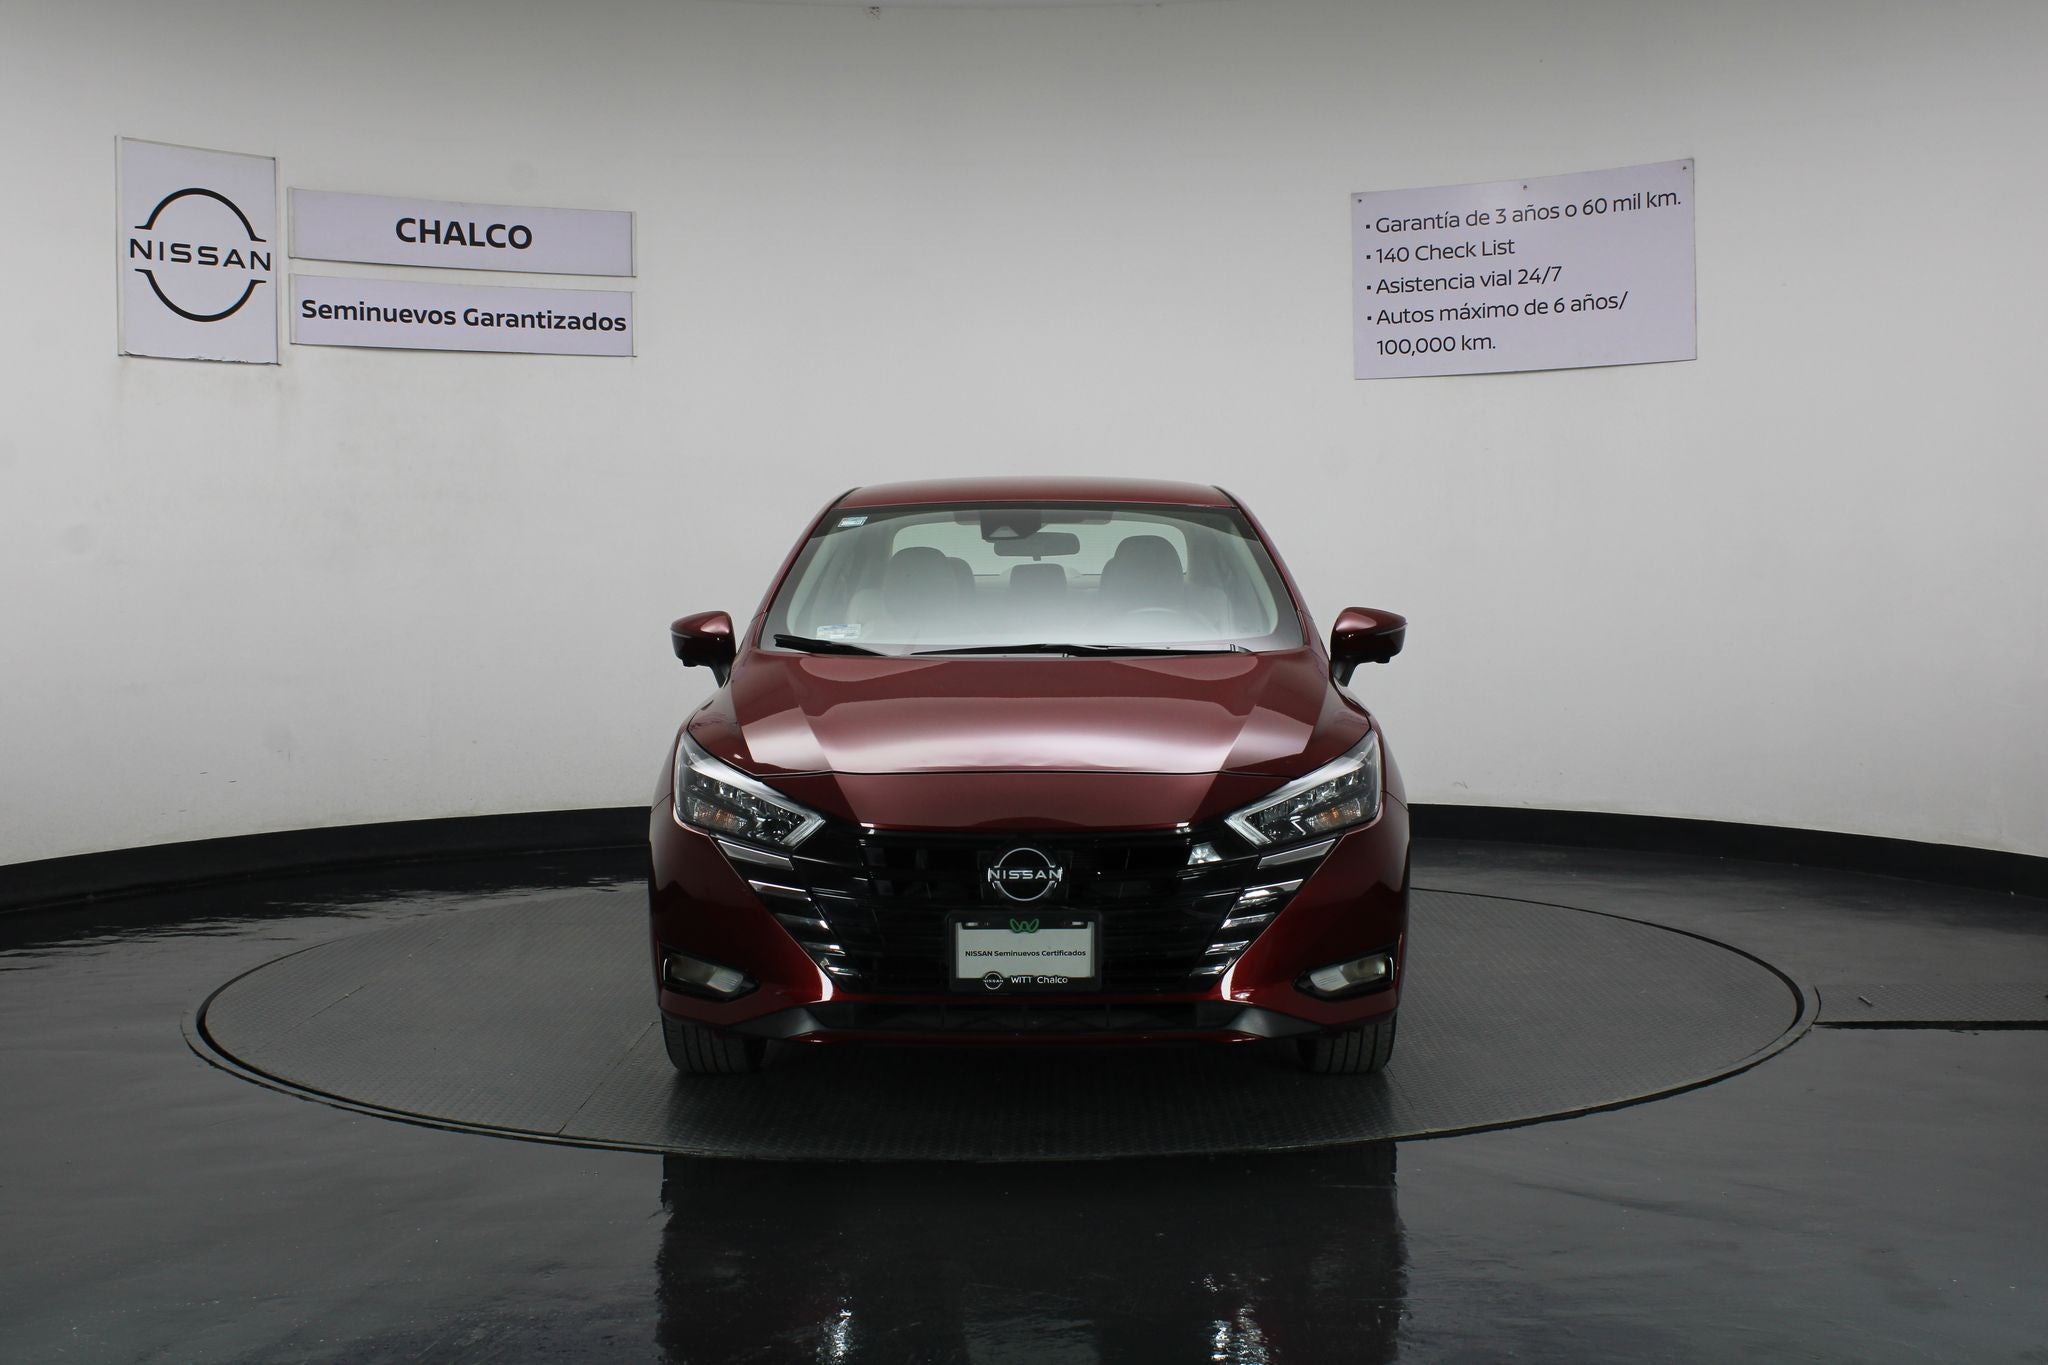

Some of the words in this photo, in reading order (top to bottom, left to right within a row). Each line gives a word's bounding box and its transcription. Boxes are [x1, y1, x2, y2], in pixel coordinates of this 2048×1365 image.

[1375, 210, 1461, 234] Garantía
[1465, 209, 1490, 227] de
[1495, 208, 1507, 225] 3
[1512, 204, 1560, 223] años
[1564, 204, 1578, 218] o
[1582, 197, 1608, 216] 60
[1613, 192, 1641, 213] mil
[1646, 191, 1682, 208] km.
[395, 217, 533, 250] CHALCO
[129, 238, 271, 272] NISSAN
[1375, 246, 1410, 264] 140
[1414, 241, 1477, 262] Check
[1481, 238, 1516, 257] List
[1375, 272, 1475, 295] Asistencia
[1479, 269, 1512, 288] vial
[1517, 265, 1563, 285] 24/7
[301, 299, 457, 326] Seminuevos
[462, 307, 627, 332] Garantizados
[1376, 307, 1435, 326] Autos
[1439, 302, 1520, 322] máximo
[1523, 298, 1549, 316] de
[1553, 297, 1566, 314] 6
[1570, 290, 1629, 313] años/
[1376, 336, 1456, 357] 100,000
[1461, 334, 1496, 352] km.
[988, 868, 1062, 881] NISSAN
[994, 949, 1040, 957] Seminuevos
[1041, 949, 1086, 957] Certificados
[1010, 976, 1033, 984] WITT
[1037, 976, 1068, 984] Chalco
